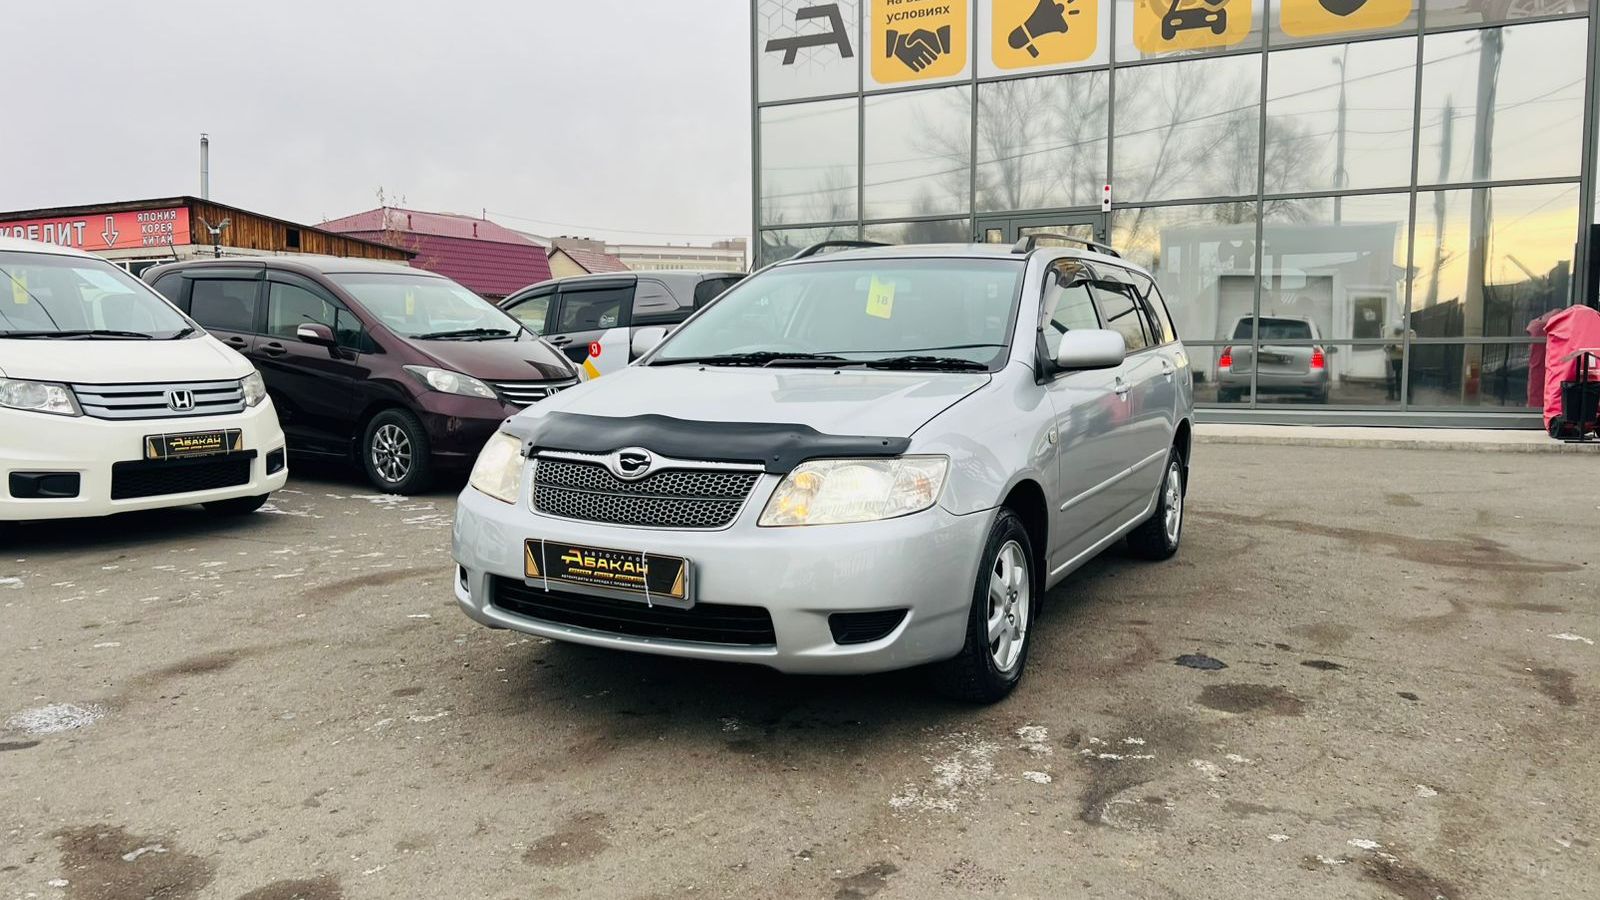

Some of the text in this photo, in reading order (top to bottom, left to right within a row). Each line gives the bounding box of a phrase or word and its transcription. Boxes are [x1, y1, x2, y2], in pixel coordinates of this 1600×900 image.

[886, 5, 950, 25] условиях
[137, 210, 176, 222] ЯПОНИЯ
[0, 221, 86, 246] КРЕДИТ
[142, 222, 173, 234] КОРЕЯ
[143, 232, 173, 246] КИТАЙ
[591, 343, 598, 355] Я
[561, 549, 648, 575] АБАКАН
